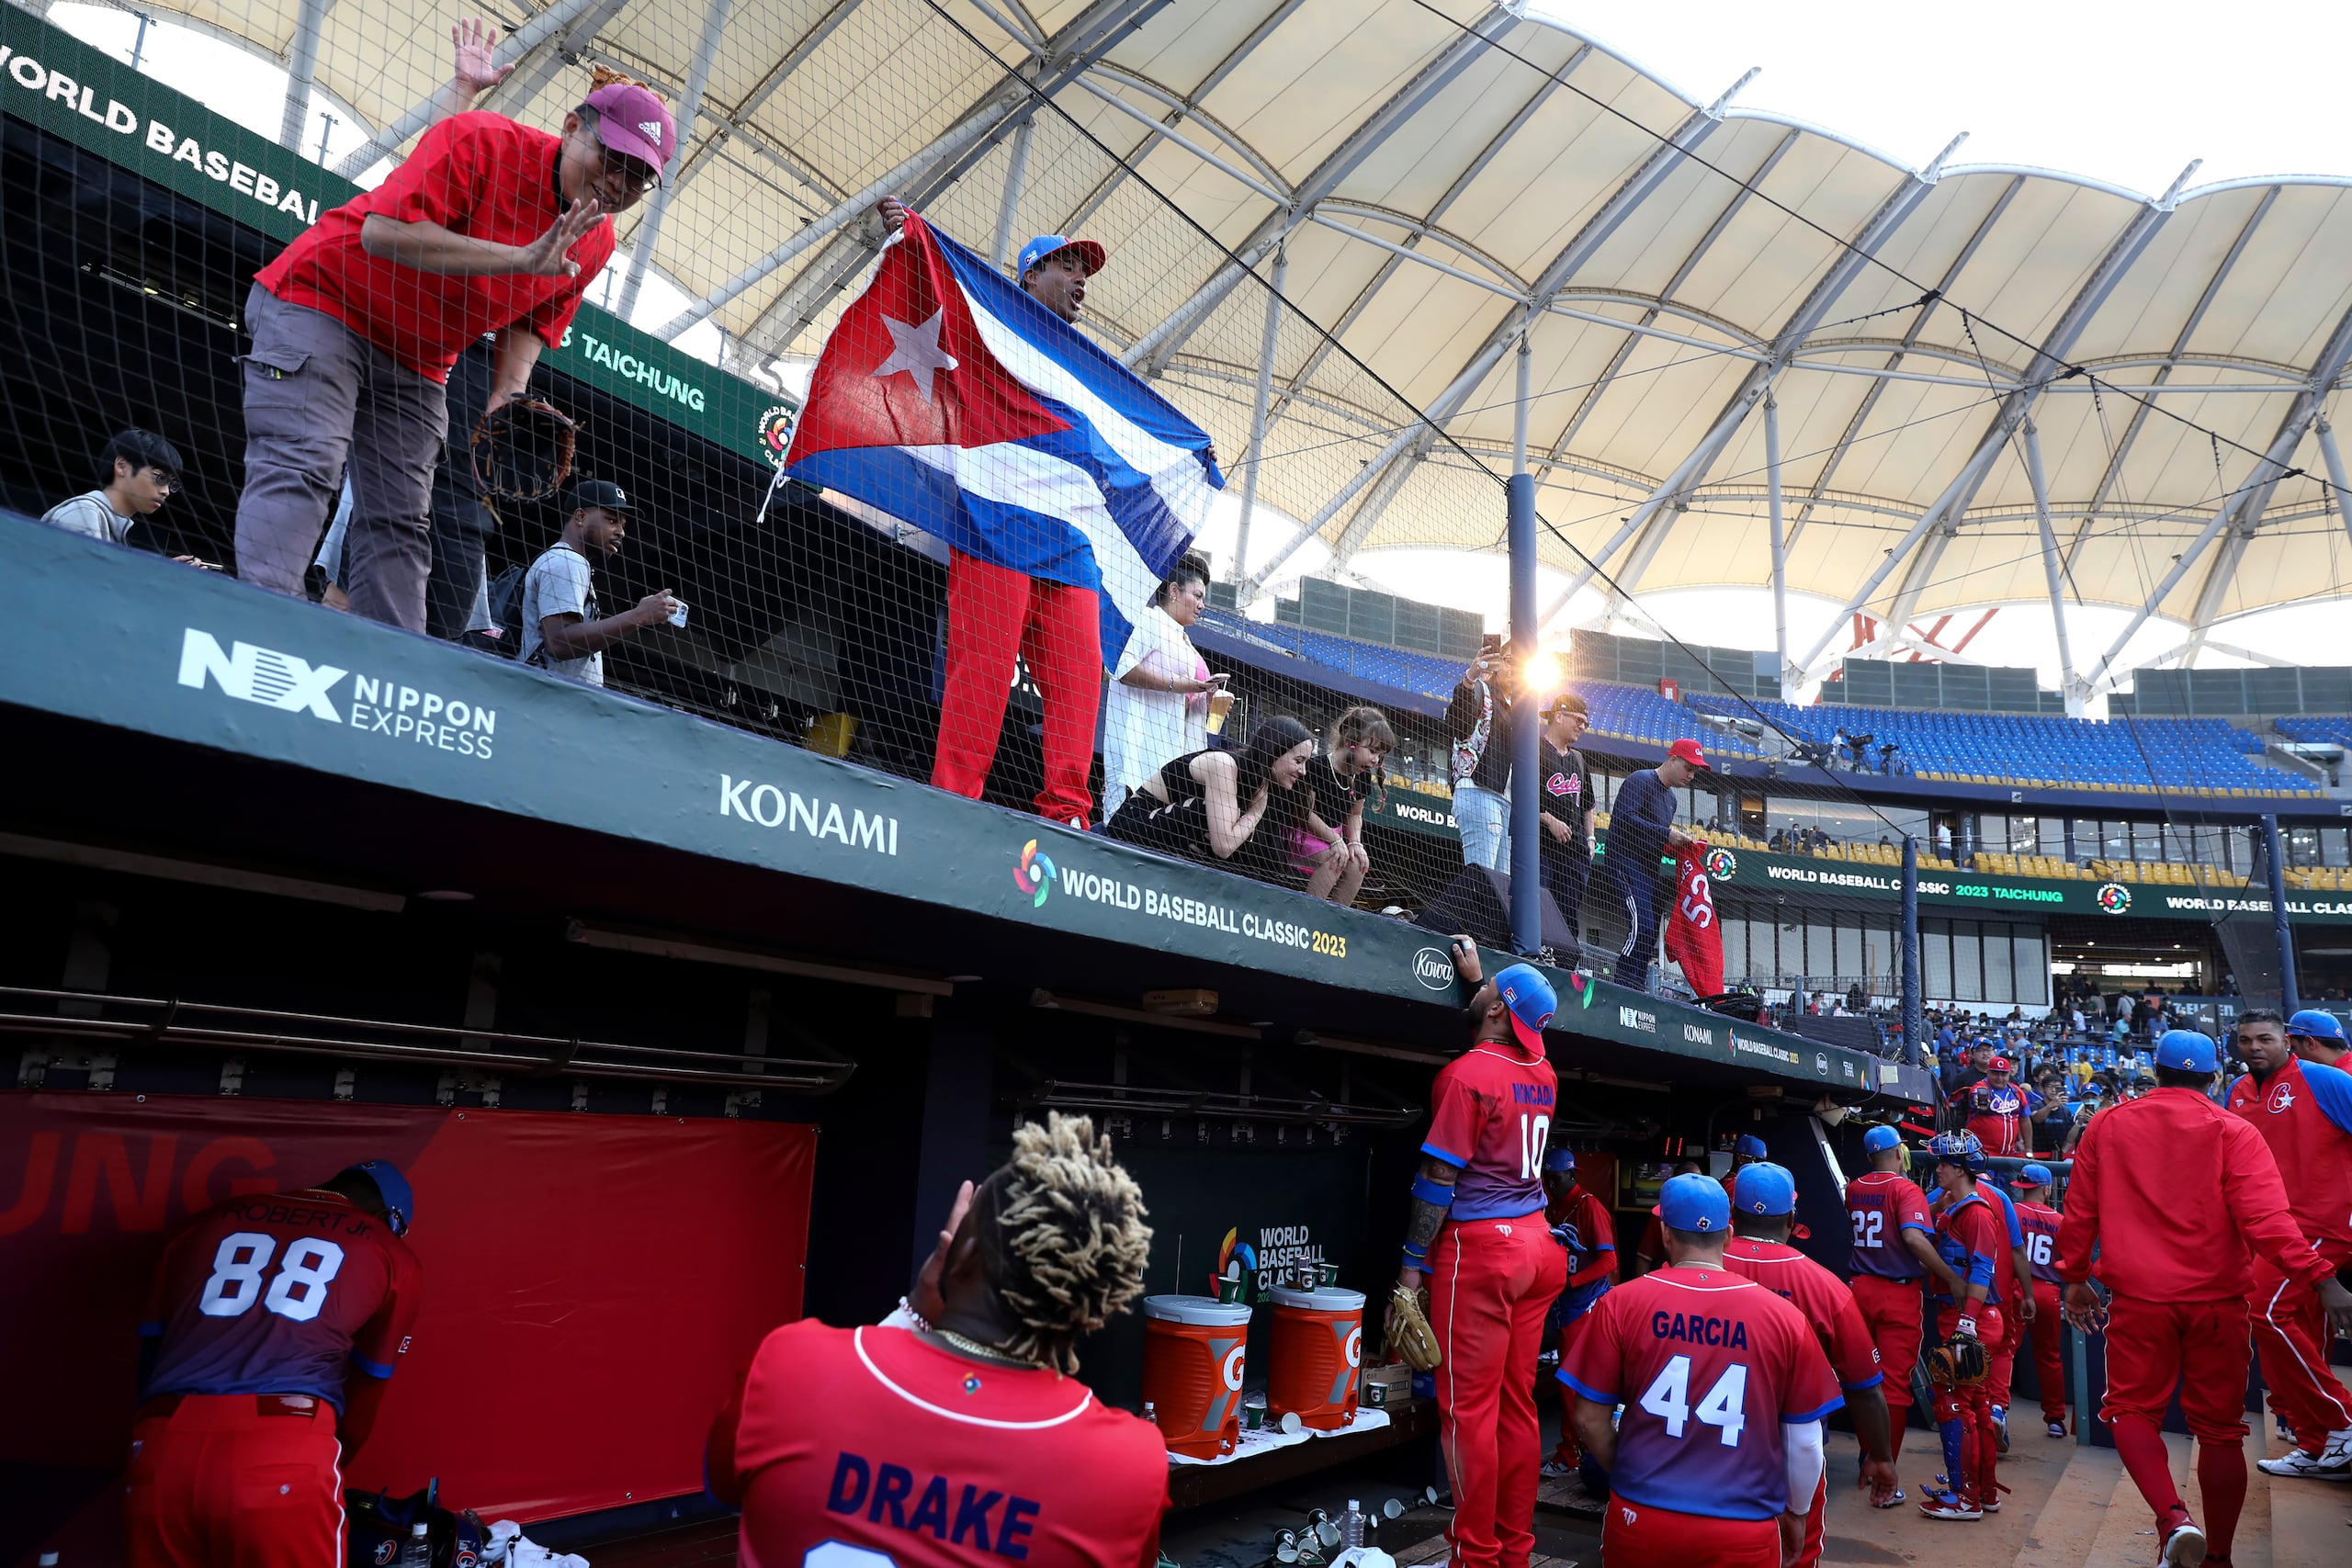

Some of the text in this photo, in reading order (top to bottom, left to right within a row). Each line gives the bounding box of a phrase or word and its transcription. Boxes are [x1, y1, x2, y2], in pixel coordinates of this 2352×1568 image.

[145, 118, 320, 226] BASEBAL
[582, 333, 706, 413] TAICHUNG
[354, 674, 497, 735] NIPPON
[350, 703, 493, 760] EXPRESS
[719, 773, 899, 856] KONAMI
[1396, 803, 1445, 825] WORLD
[1767, 866, 2064, 903] WORLD BASEBALL CSSIC 2023 TAICHUNG
[1061, 867, 1347, 960] WORLD BASEBALL CLASSIC 2023
[2165, 897, 2225, 910] WORLD
[1417, 952, 1453, 981] Kowa
[1637, 1010, 1656, 1024] NIPPON
[1637, 1021, 1656, 1033] EXPRESS
[1683, 1023, 1713, 1045] KONAMI
[1736, 1038, 1754, 1053] WORLD
[1521, 1112, 1551, 1180] 10
[220, 1203, 350, 1231] ROBERT
[1851, 1194, 1886, 1207] ALVAREZ
[1261, 1225, 1309, 1247] WORLD
[1851, 1210, 1883, 1249] 22
[1259, 1245, 1325, 1269] BASEBALL
[2026, 1232, 2053, 1266] 16
[198, 1231, 346, 1323] 88
[1258, 1268, 1294, 1291] CLAS
[1257, 1292, 1270, 1303] 202
[1652, 1311, 1748, 1350] GARCIA
[1639, 1353, 1748, 1448] 44
[827, 1451, 1041, 1560] DRAKE
